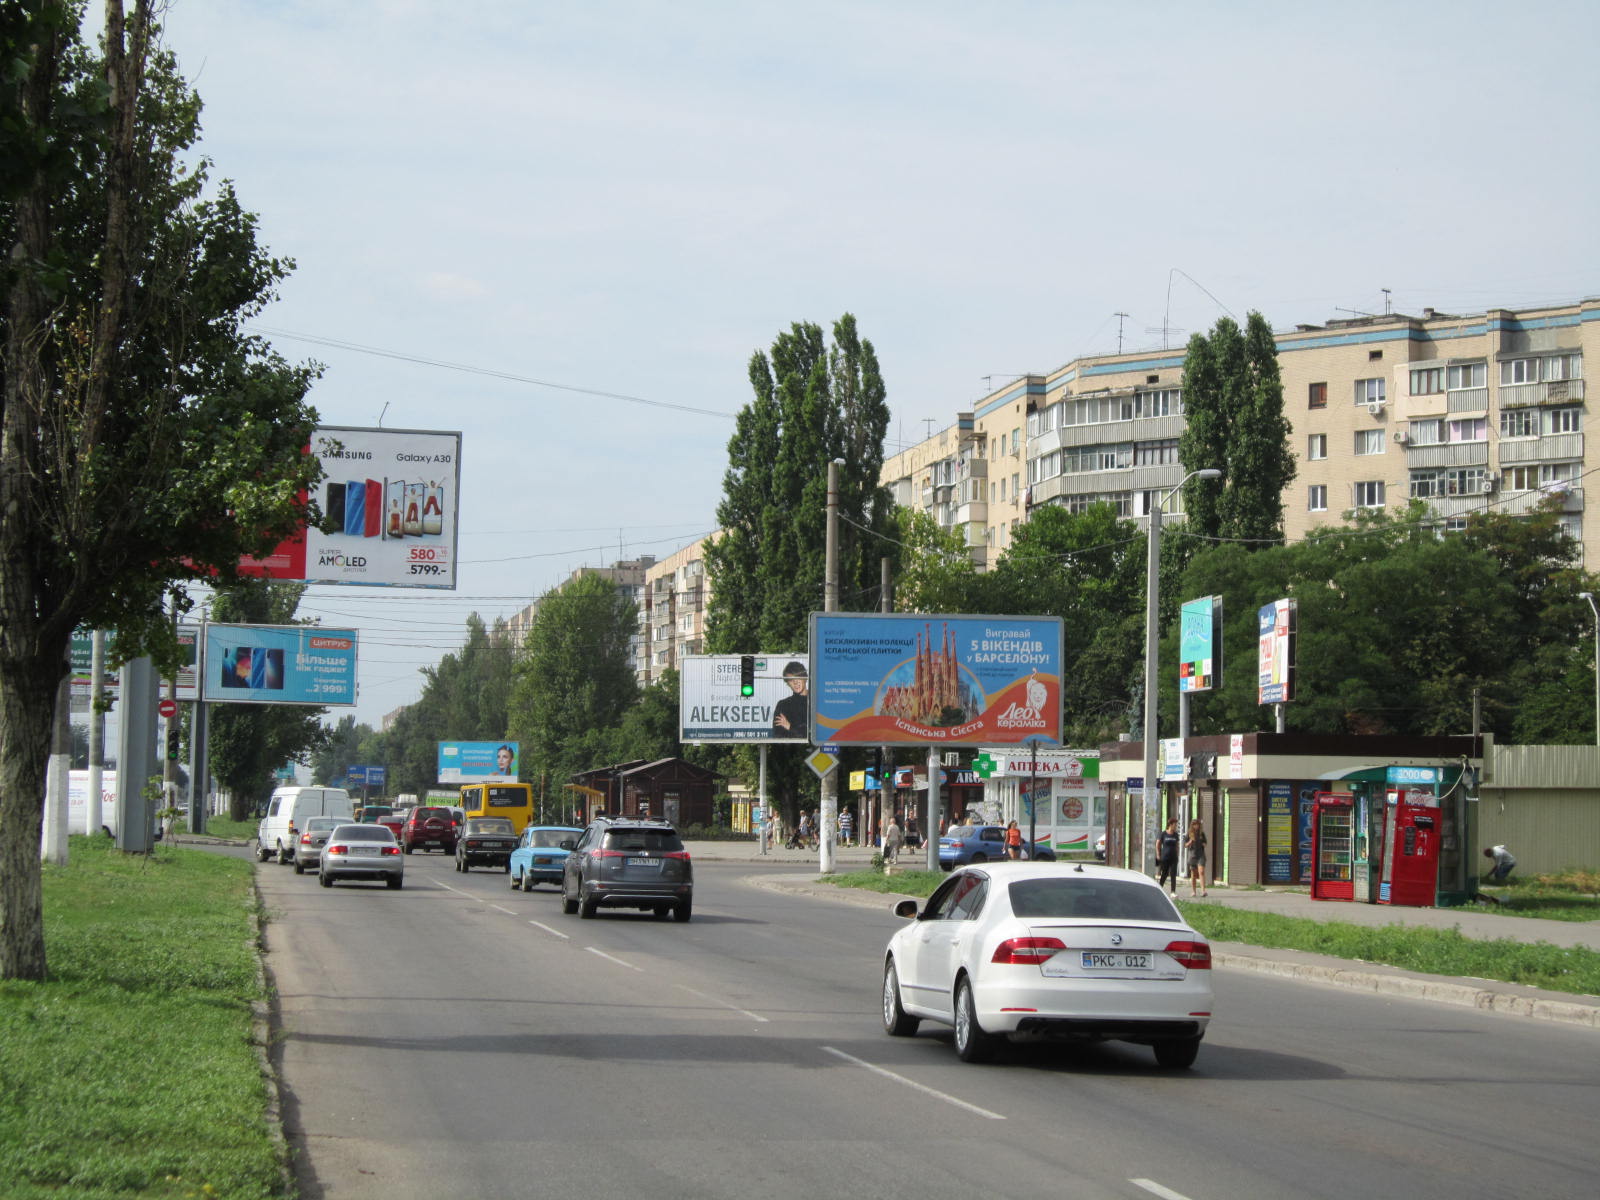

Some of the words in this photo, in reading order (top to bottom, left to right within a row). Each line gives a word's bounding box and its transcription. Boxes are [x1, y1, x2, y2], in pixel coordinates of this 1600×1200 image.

[322, 450, 372, 460] SAMSUNG
[396, 453, 431, 464] Galaxy
[433, 454, 451, 463] A30
[410, 548, 436, 560] 580
[319, 555, 367, 567] AMOLED
[985, 628, 1031, 640] Вигравай
[313, 639, 347, 648] ЦИТРУС
[971, 640, 978, 651] 5
[982, 640, 1042, 654] ВІКЕНДІВ
[825, 646, 870, 655] ІСПАНСЬКОЇ
[871, 647, 902, 656] ПЛИТКИ
[297, 653, 347, 666] Більше
[967, 655, 973, 663] у
[975, 653, 1050, 665] БАРСЕЛОНУ!
[717, 664, 742, 674] STERE
[690, 705, 771, 723] ALEKSEEV
[997, 702, 1034, 720] Лео
[895, 718, 946, 738] Іспанська
[950, 721, 984, 737] Сієста
[997, 718, 1046, 729] кераміка
[1008, 761, 1060, 772] АПТЕКА
